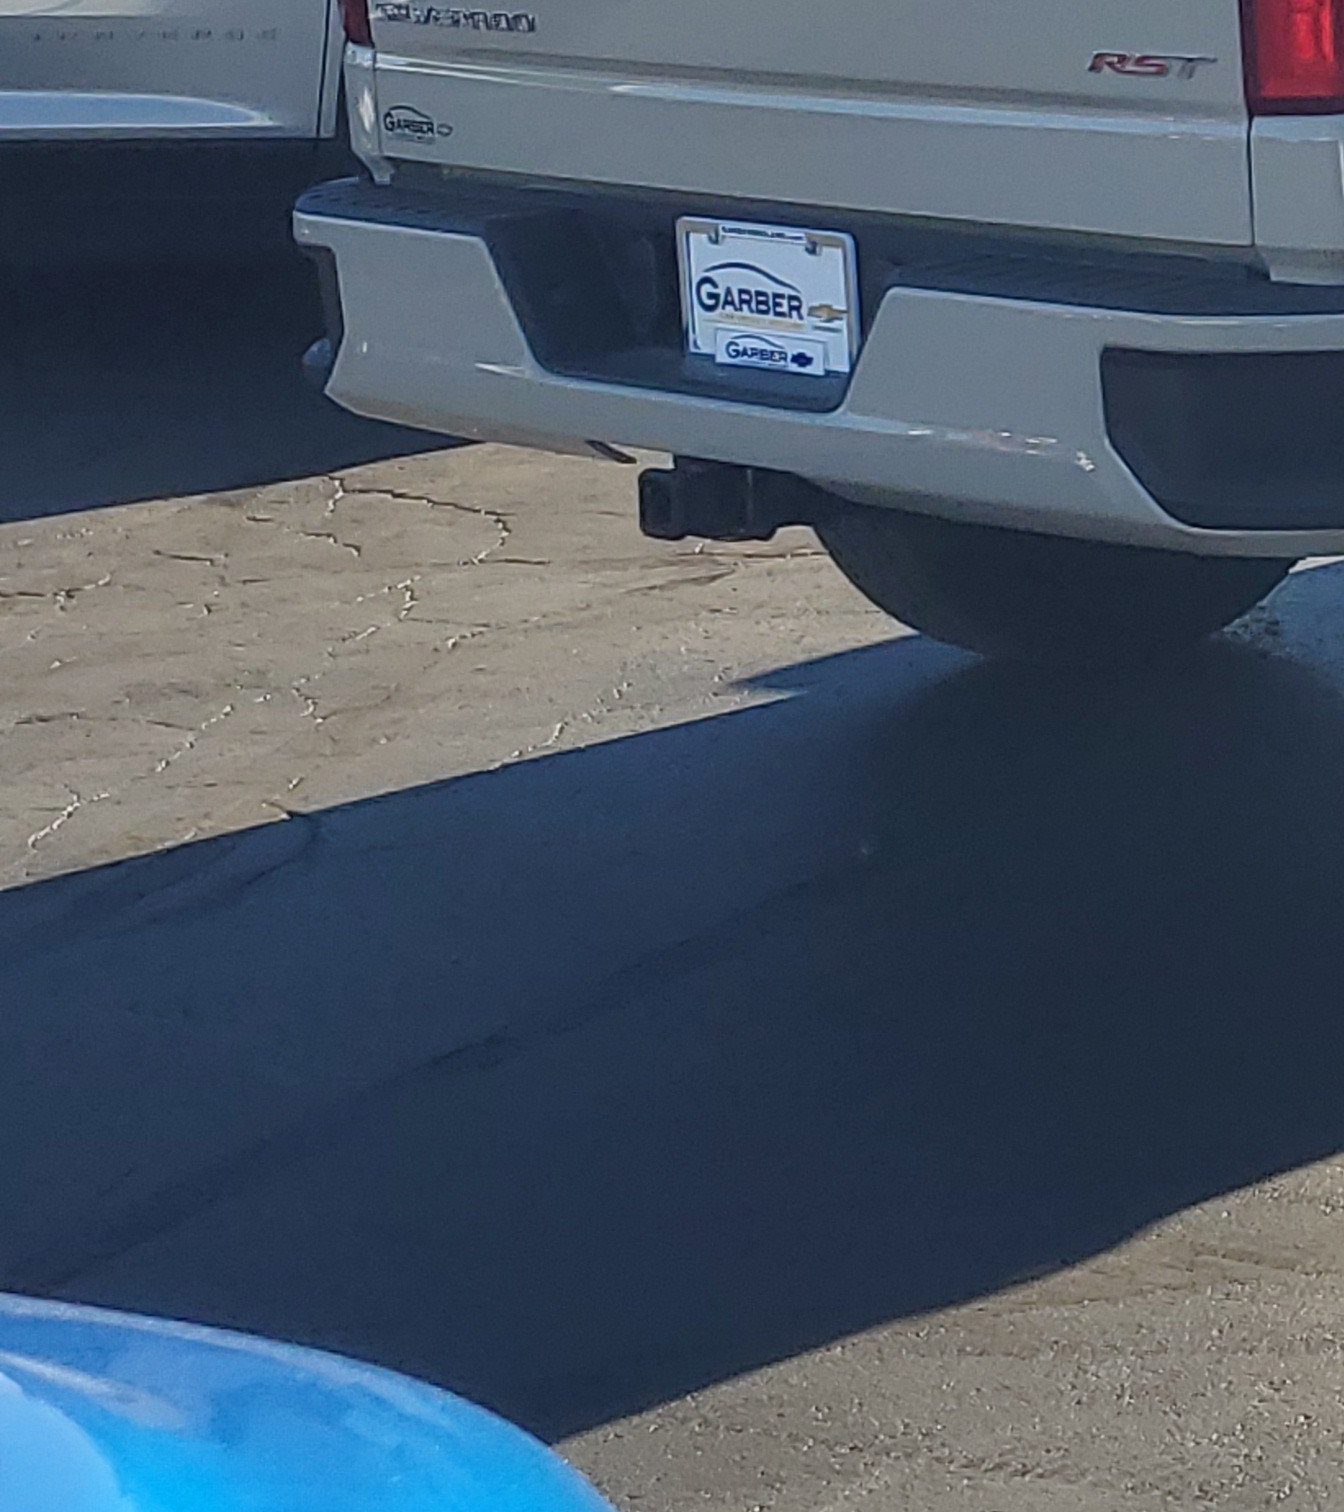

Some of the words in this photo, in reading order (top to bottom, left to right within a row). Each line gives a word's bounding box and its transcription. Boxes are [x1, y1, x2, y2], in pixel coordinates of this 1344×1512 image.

[1088, 50, 1218, 80] RST
[695, 275, 805, 321] GARBER
[725, 340, 788, 363] GARBER
